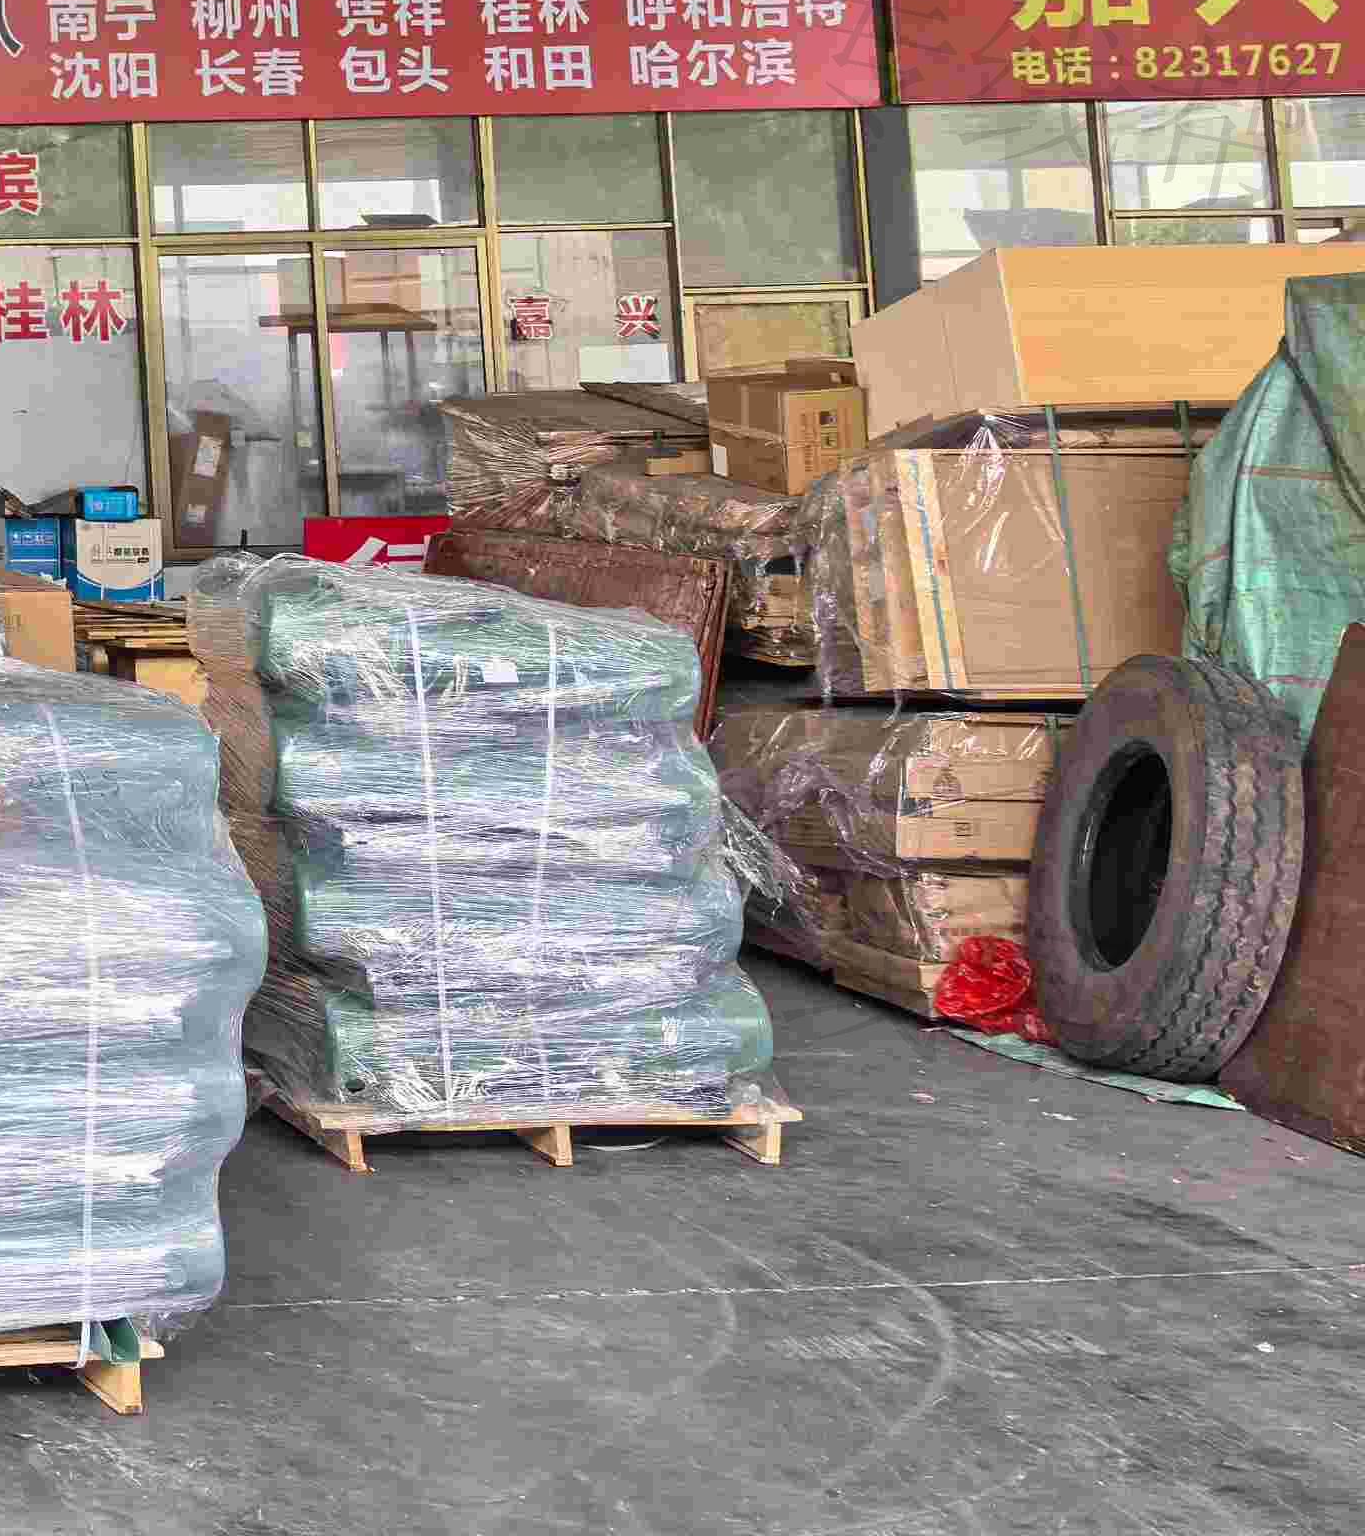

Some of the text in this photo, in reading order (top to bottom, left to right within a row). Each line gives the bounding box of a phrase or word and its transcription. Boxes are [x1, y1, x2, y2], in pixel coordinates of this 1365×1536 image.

[49, 38, 797, 99] 沈阳 长春 包头 和田 哈尔滨
